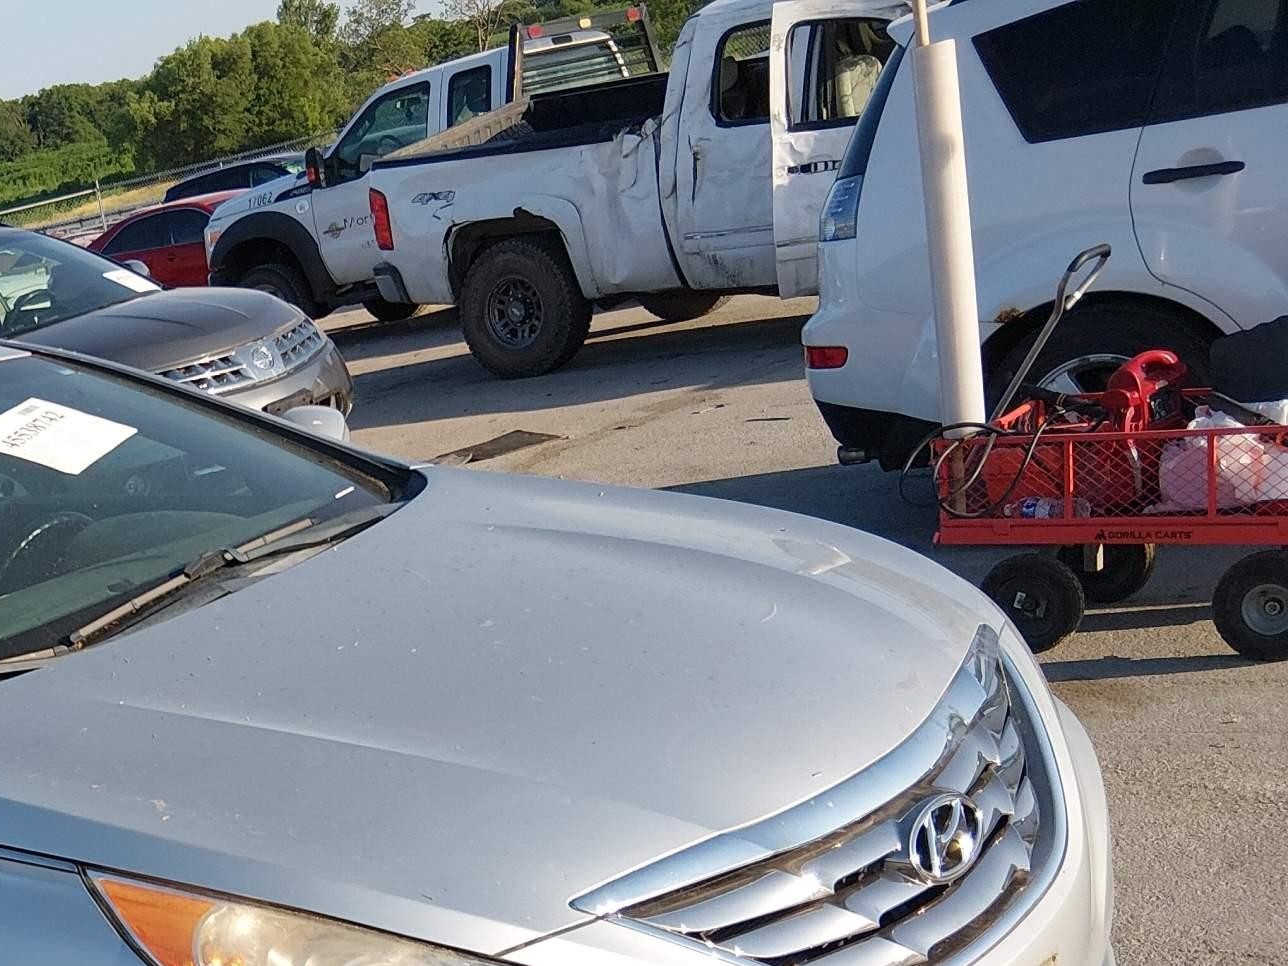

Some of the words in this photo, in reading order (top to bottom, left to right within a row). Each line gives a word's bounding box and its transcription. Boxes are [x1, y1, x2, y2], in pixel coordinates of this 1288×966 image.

[248, 191, 273, 209] 17062
[0, 410, 65, 449] 45538742
[1107, 531, 1153, 540] GORILLA
[1154, 531, 1193, 540] CARTS
